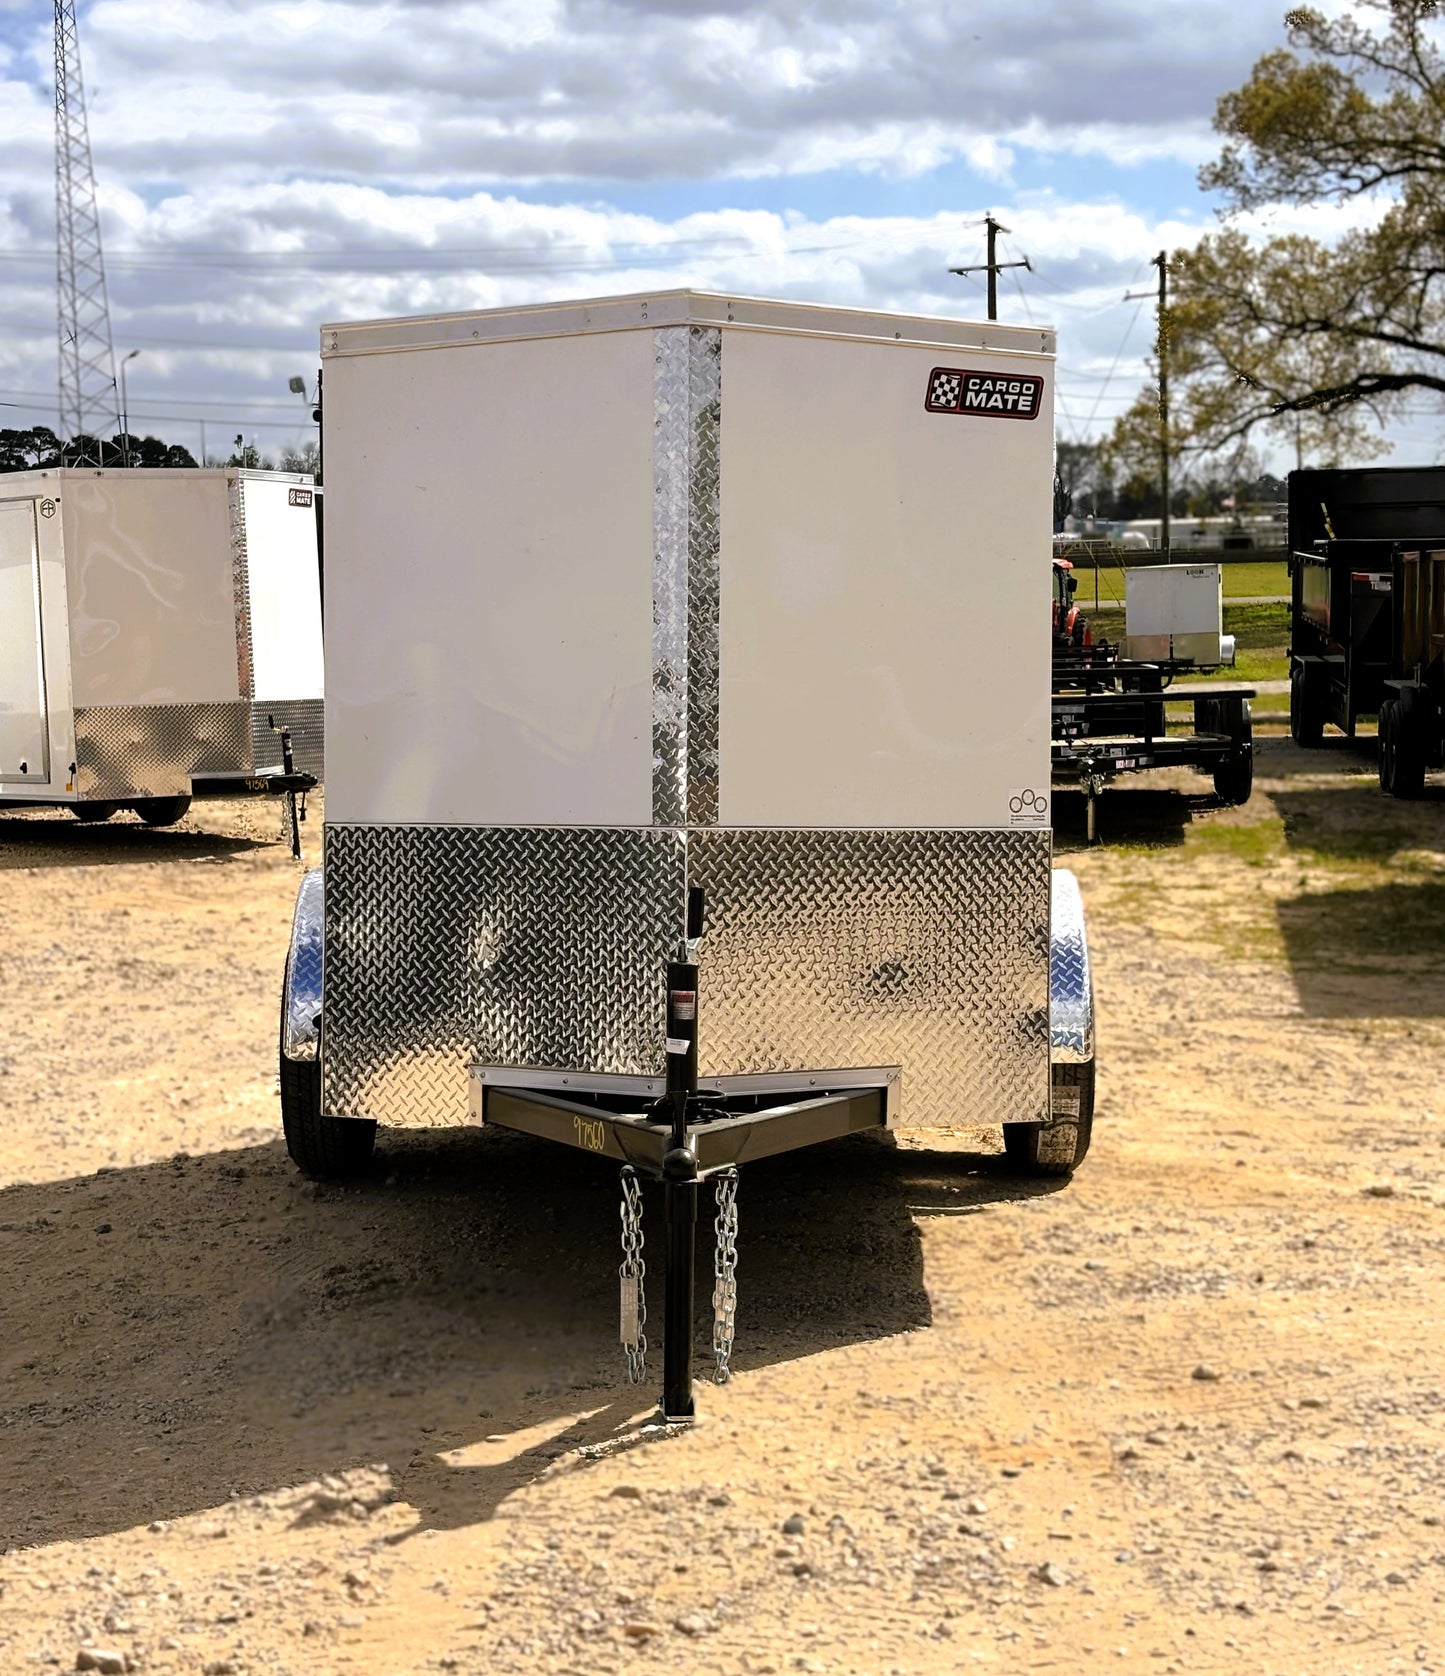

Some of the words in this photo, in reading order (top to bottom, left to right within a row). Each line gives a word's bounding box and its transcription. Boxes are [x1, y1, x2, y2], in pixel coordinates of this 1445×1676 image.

[968, 378, 1035, 395] CARGO
[965, 391, 1033, 411] MATE
[296, 497, 311, 505] MATE
[573, 1115, 605, 1150] 97560
